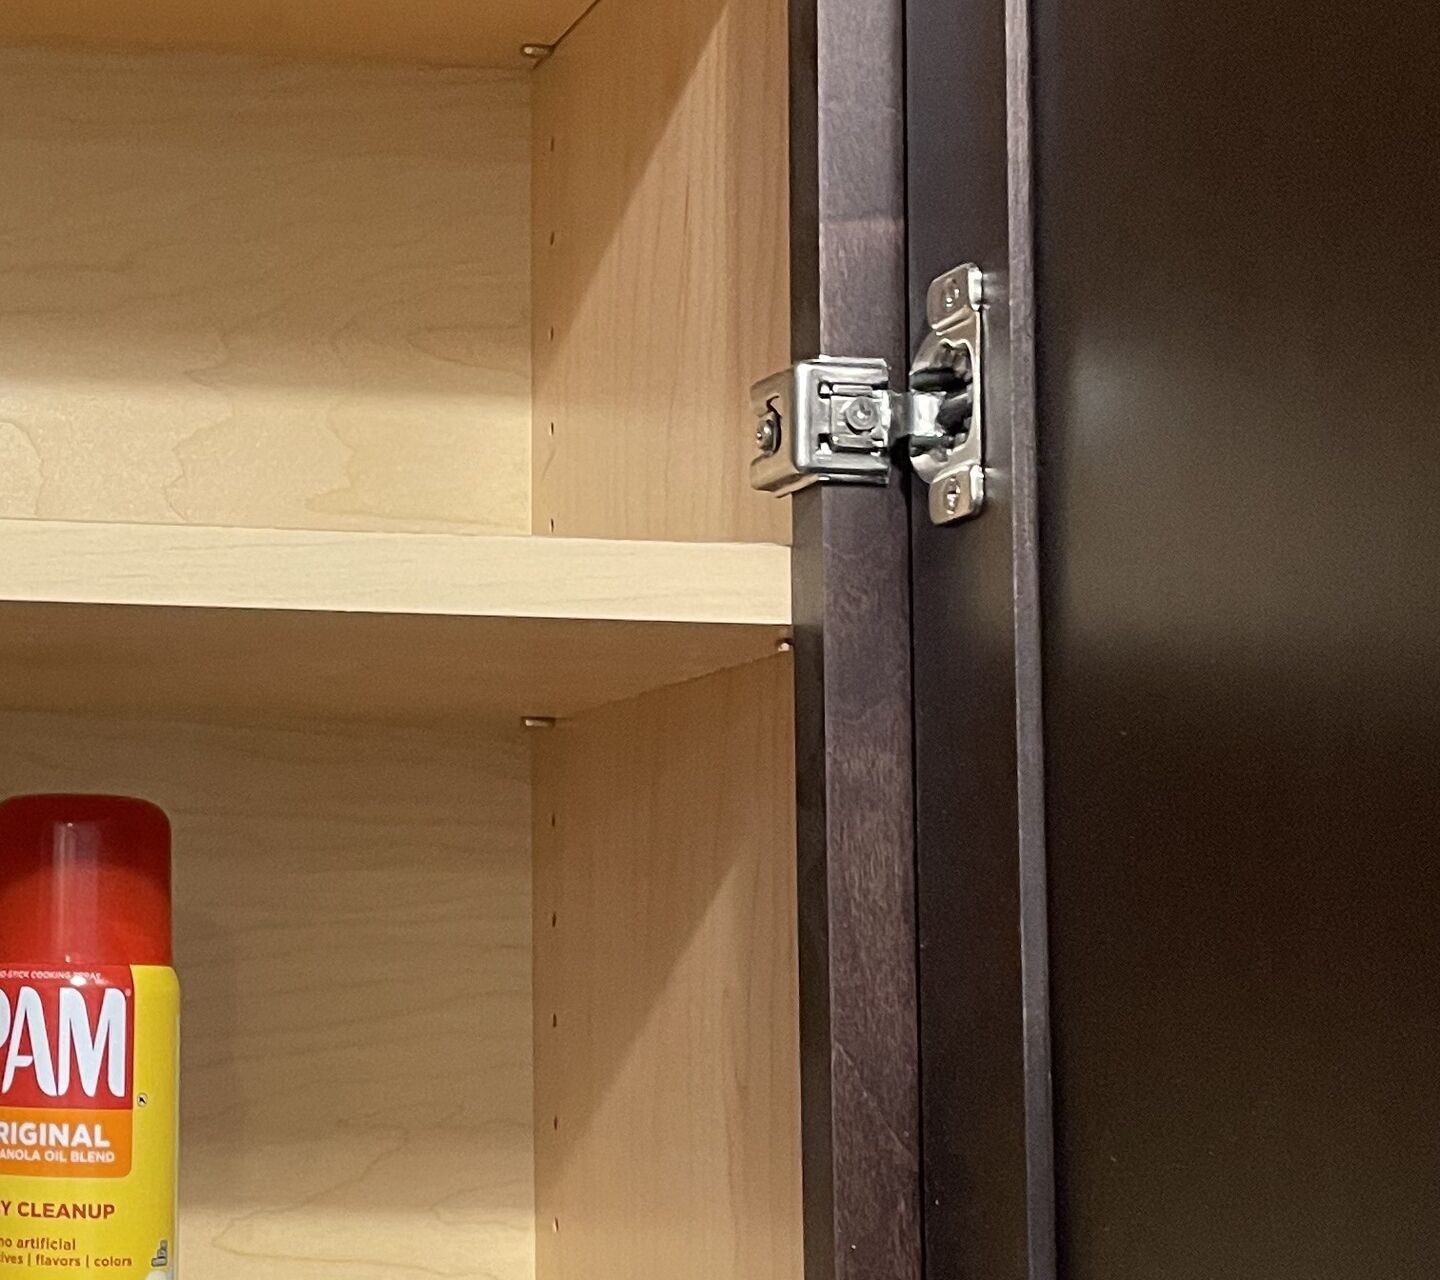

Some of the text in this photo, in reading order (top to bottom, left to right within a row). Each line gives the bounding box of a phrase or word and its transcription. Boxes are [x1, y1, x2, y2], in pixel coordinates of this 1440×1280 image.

[44, 1150, 67, 1162] OIL
[70, 1150, 115, 1163] BLEND
[17, 1201, 115, 1219] CLEANUP
[16, 1237, 76, 1251] artificial
[35, 1253, 81, 1267] flavors
[94, 1255, 133, 1268] colors
